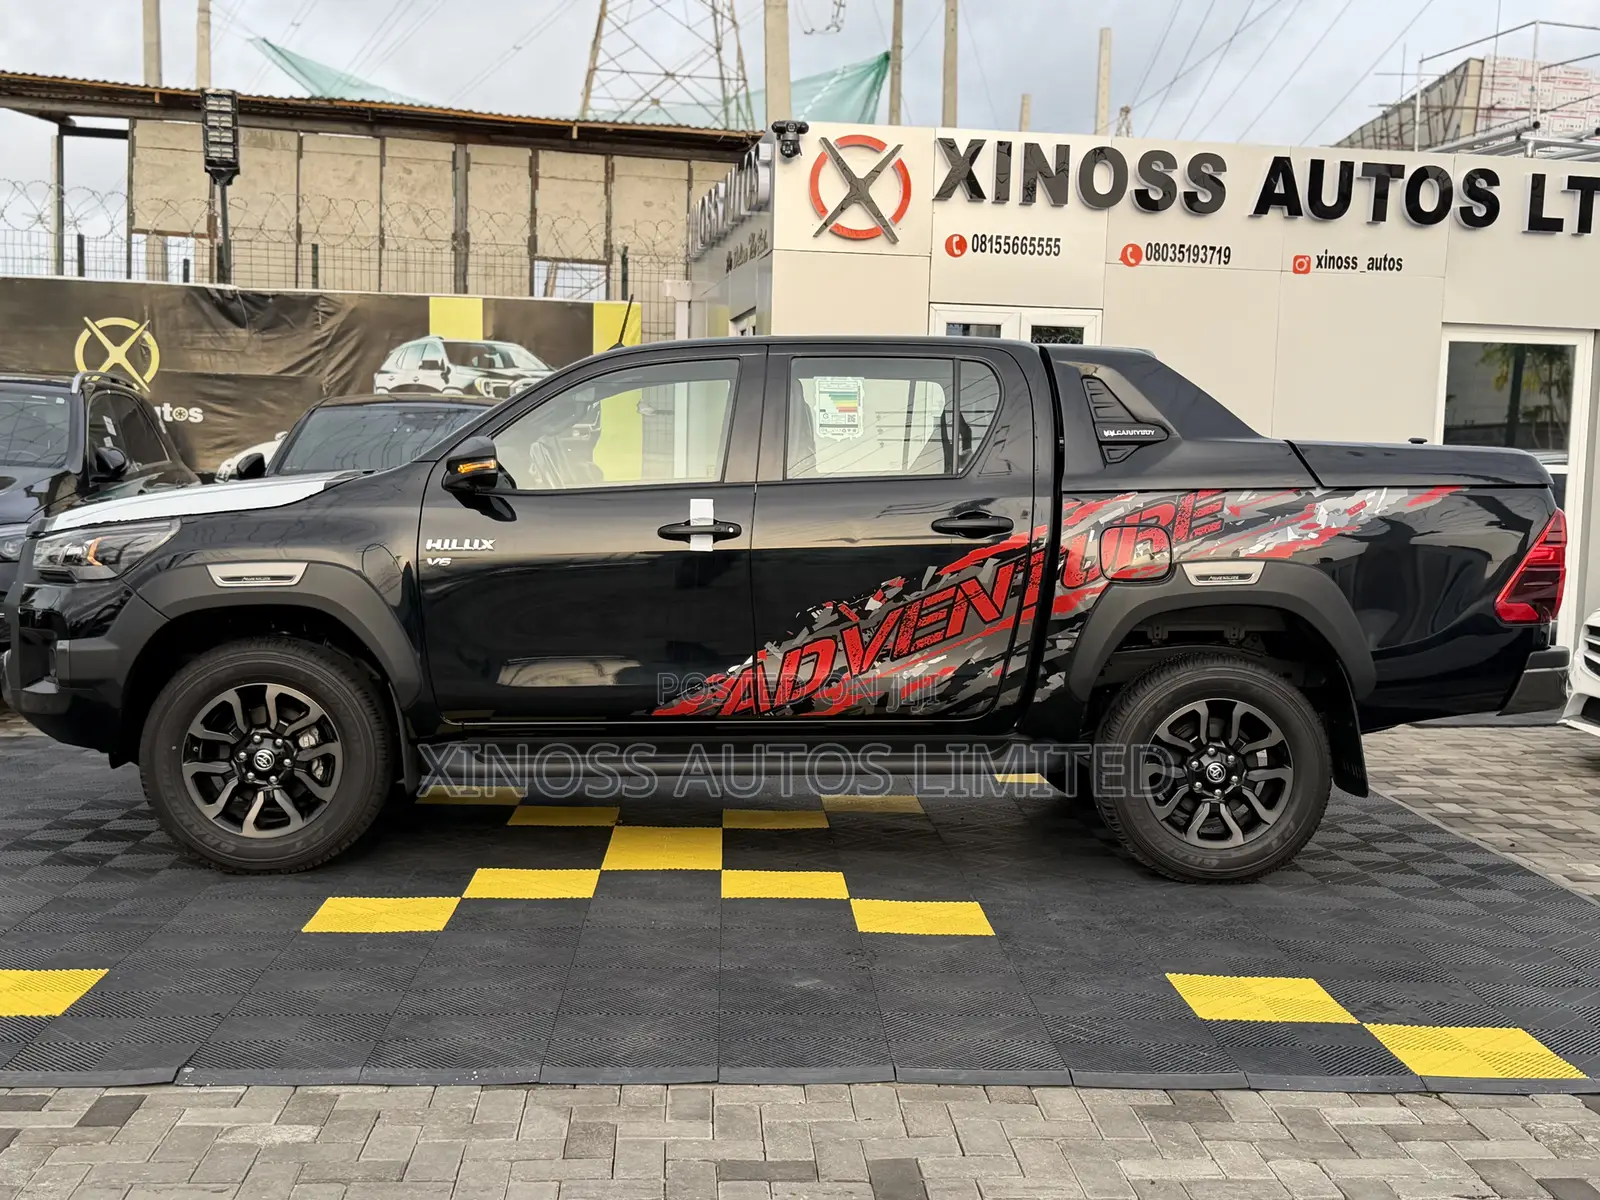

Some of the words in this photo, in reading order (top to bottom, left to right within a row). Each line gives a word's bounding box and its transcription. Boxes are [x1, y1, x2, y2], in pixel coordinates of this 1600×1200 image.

[933, 137, 1228, 215] XINOSS
[1250, 155, 1501, 229] AUTOS
[971, 233, 1061, 257] 08155665555
[1145, 242, 1232, 266] 08035193719
[1316, 249, 1403, 273] xinoss_autos
[425, 538, 496, 551] HILUX
[426, 557, 452, 567] V6
[714, 489, 1230, 717] ADVENTURE
